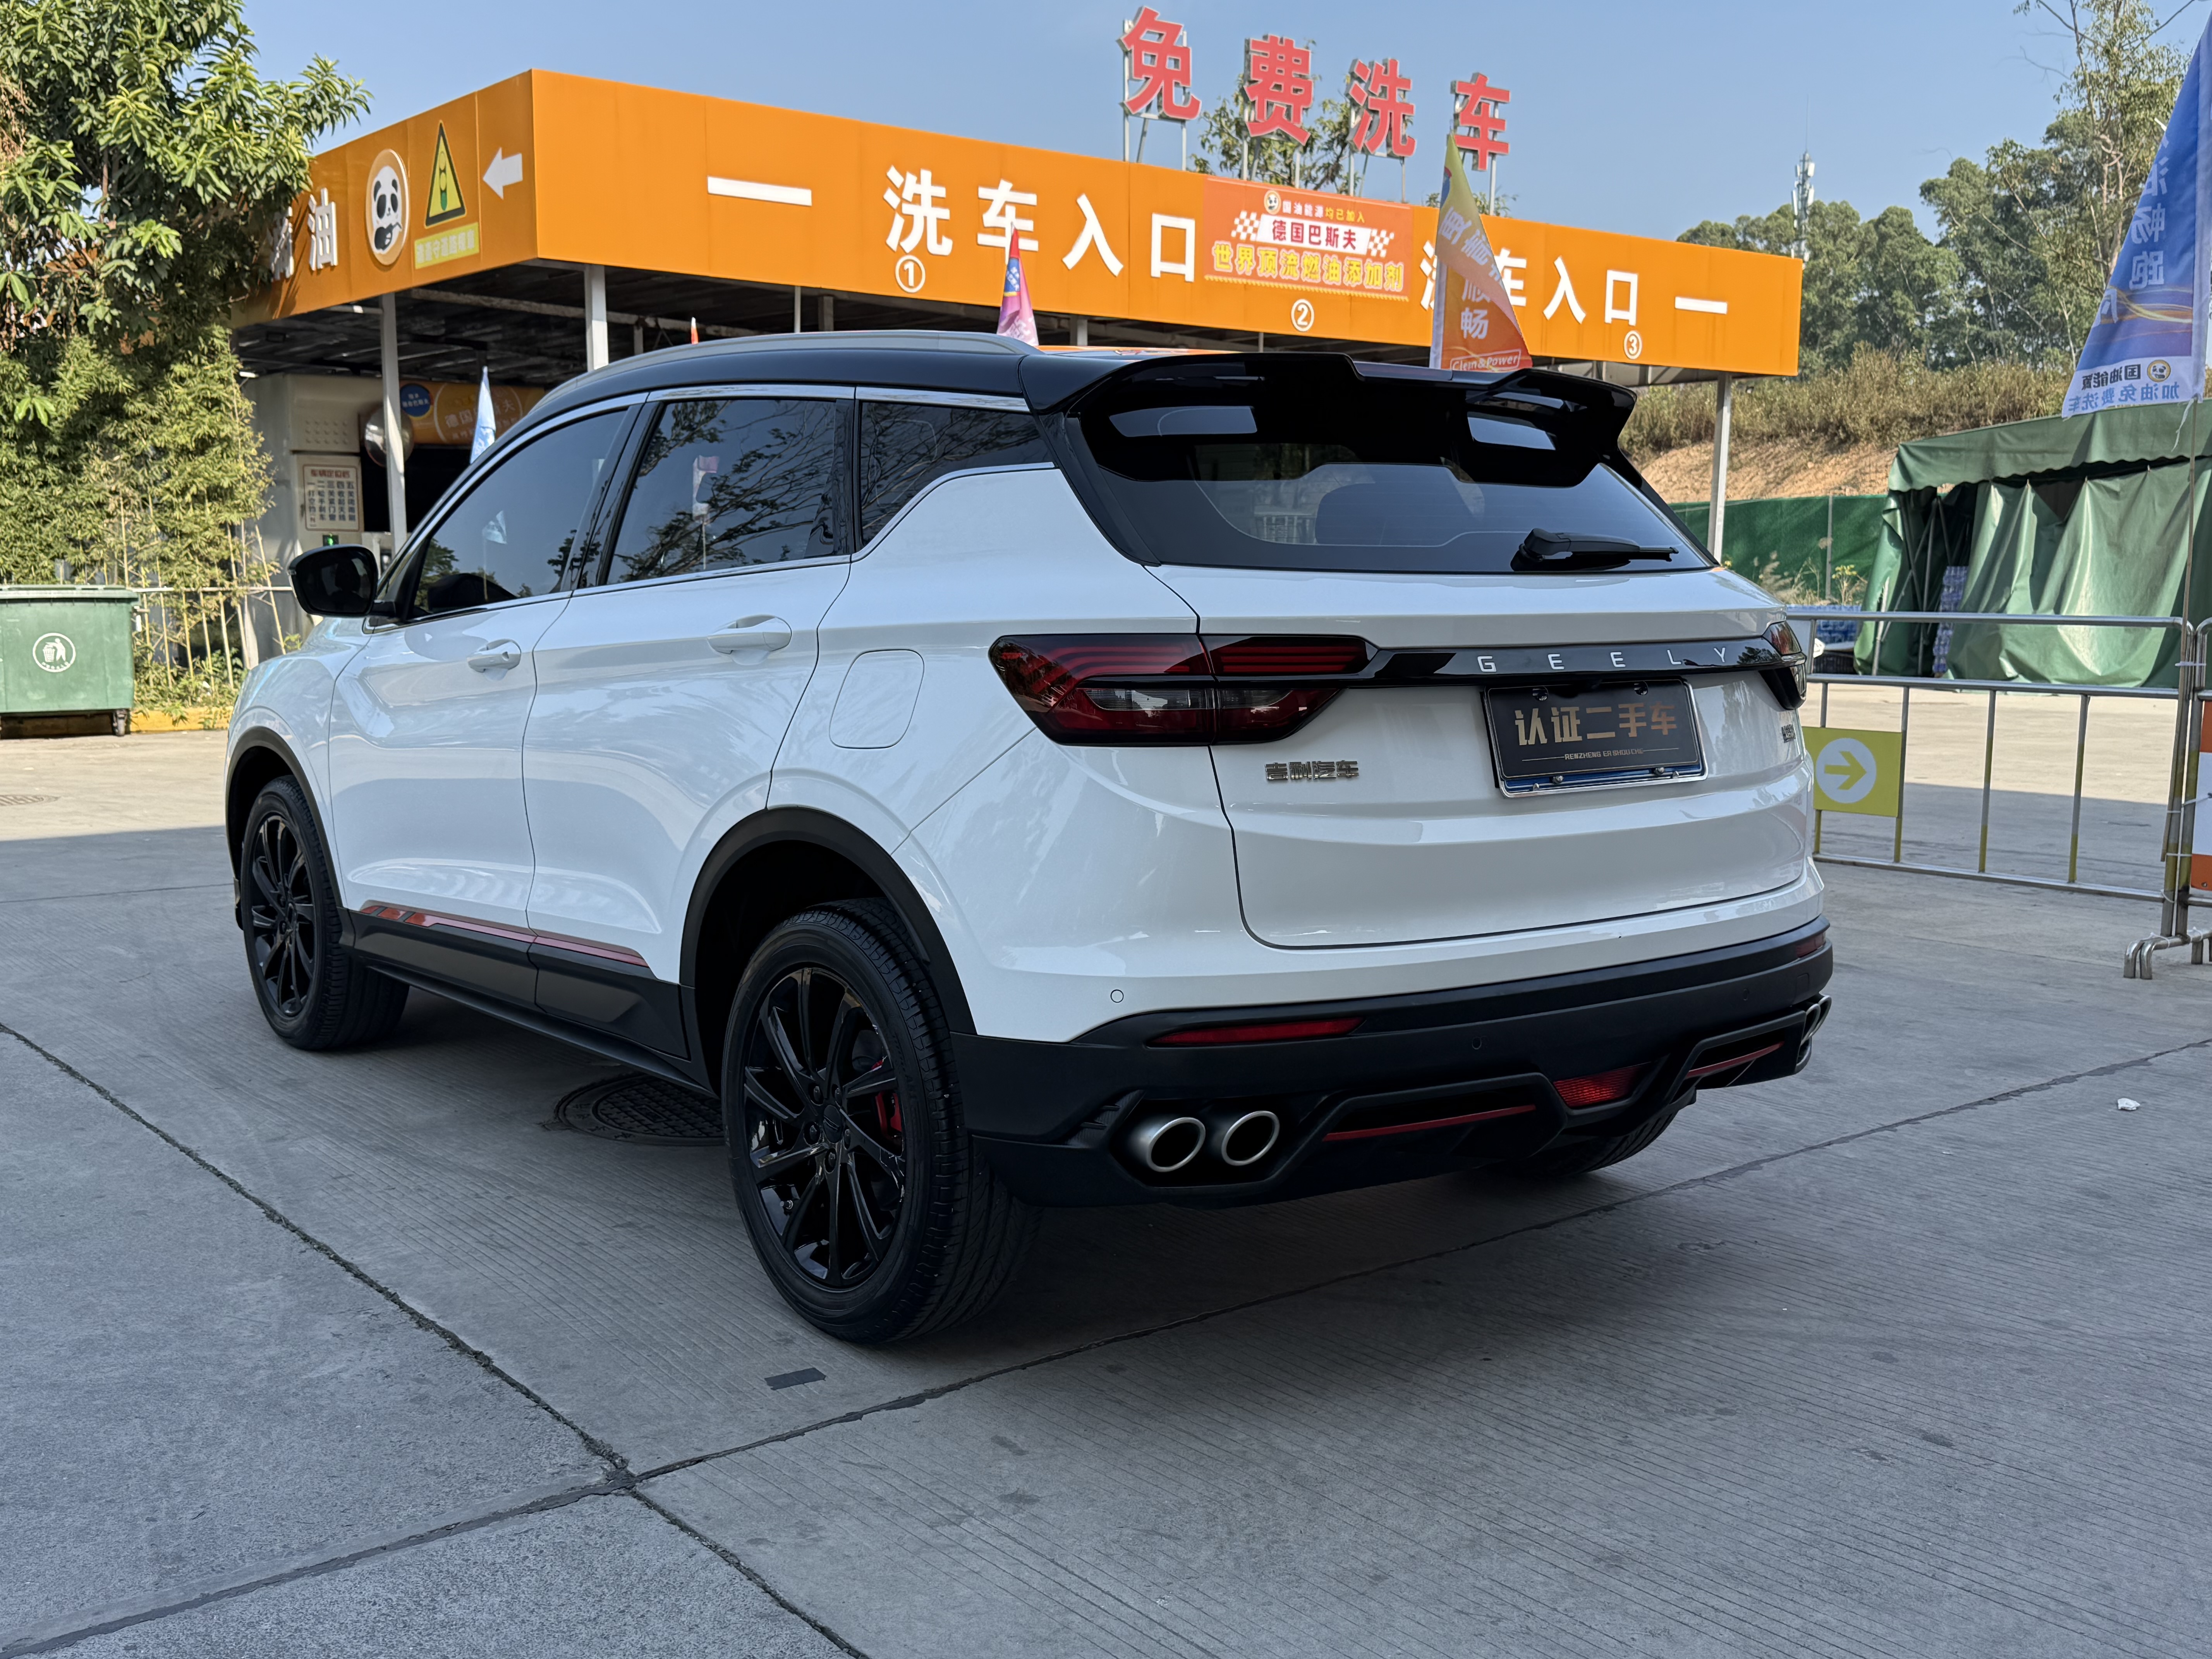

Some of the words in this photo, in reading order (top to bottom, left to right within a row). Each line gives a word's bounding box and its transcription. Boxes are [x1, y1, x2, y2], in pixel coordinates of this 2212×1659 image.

[1117, 6, 1511, 171] 免费洗车
[883, 165, 1195, 282] 洗车入口
[1272, 220, 1357, 251] 德国巴斯夫
[1212, 241, 1404, 292] 世界顶流燃油添加剂
[1420, 240, 1638, 326] 车入口
[1477, 647, 1726, 672] GEELY
[1515, 701, 1678, 745] 认证二手车
[1265, 760, 1359, 780] 吉利汽车
[1565, 751, 1601, 760] RENZHENG
